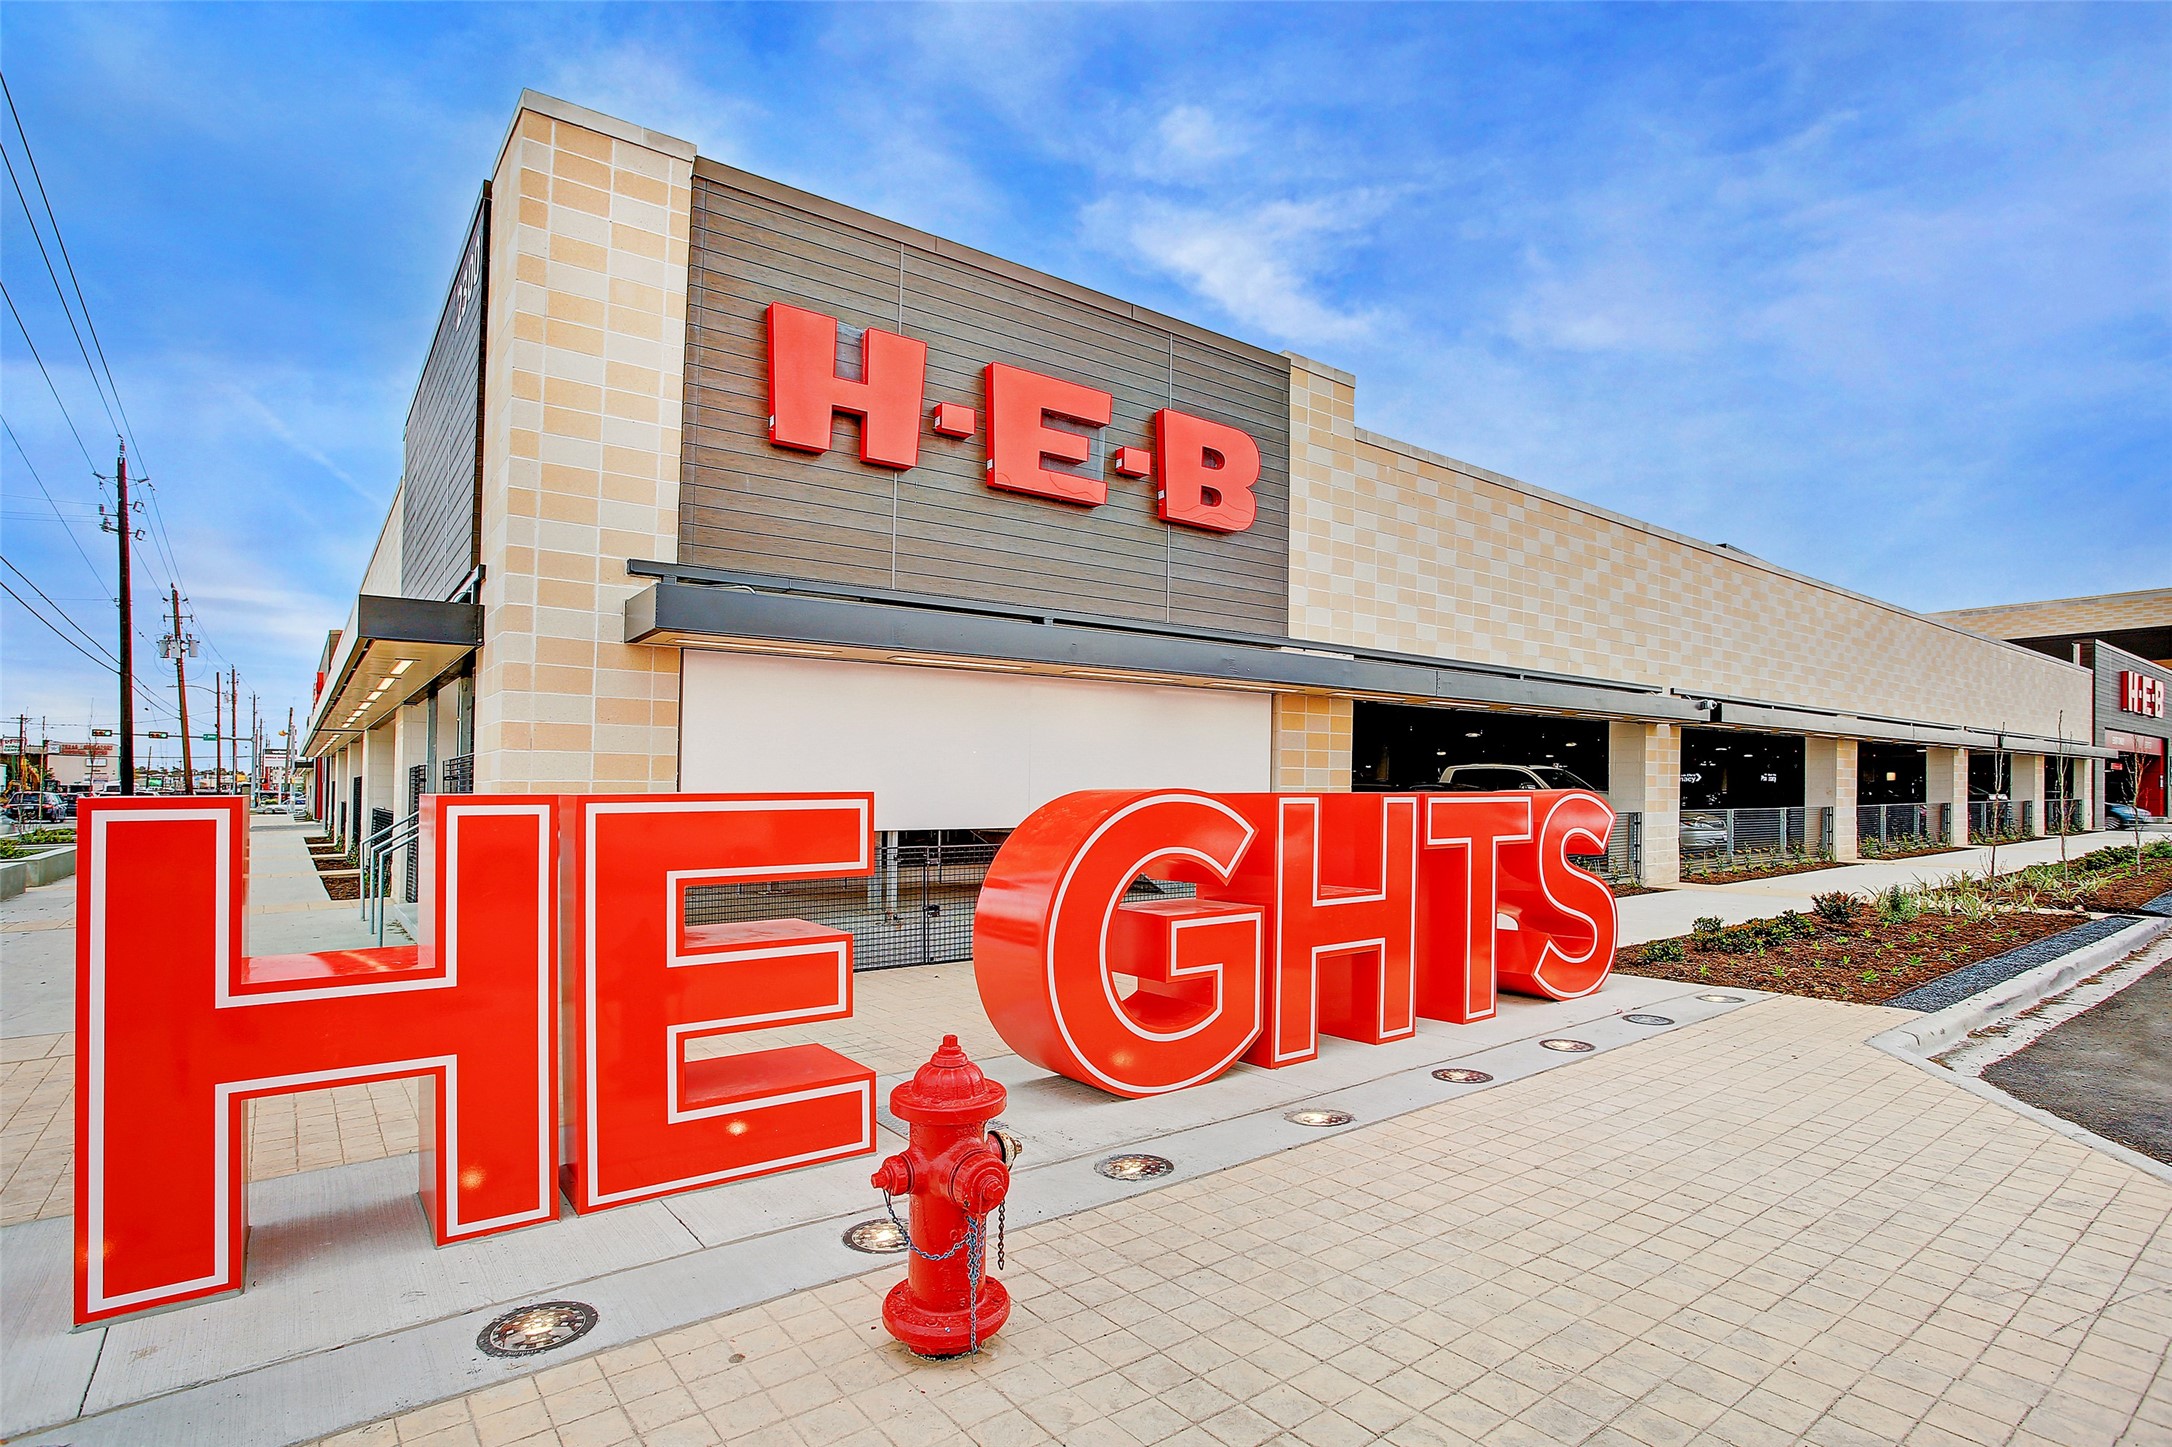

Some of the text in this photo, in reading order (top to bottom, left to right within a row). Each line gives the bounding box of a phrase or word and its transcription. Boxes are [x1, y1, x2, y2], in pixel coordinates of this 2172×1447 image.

[455, 236, 480, 332] 2300
[766, 301, 1261, 534] H-E-B
[2121, 670, 2164, 718] H-E-B
